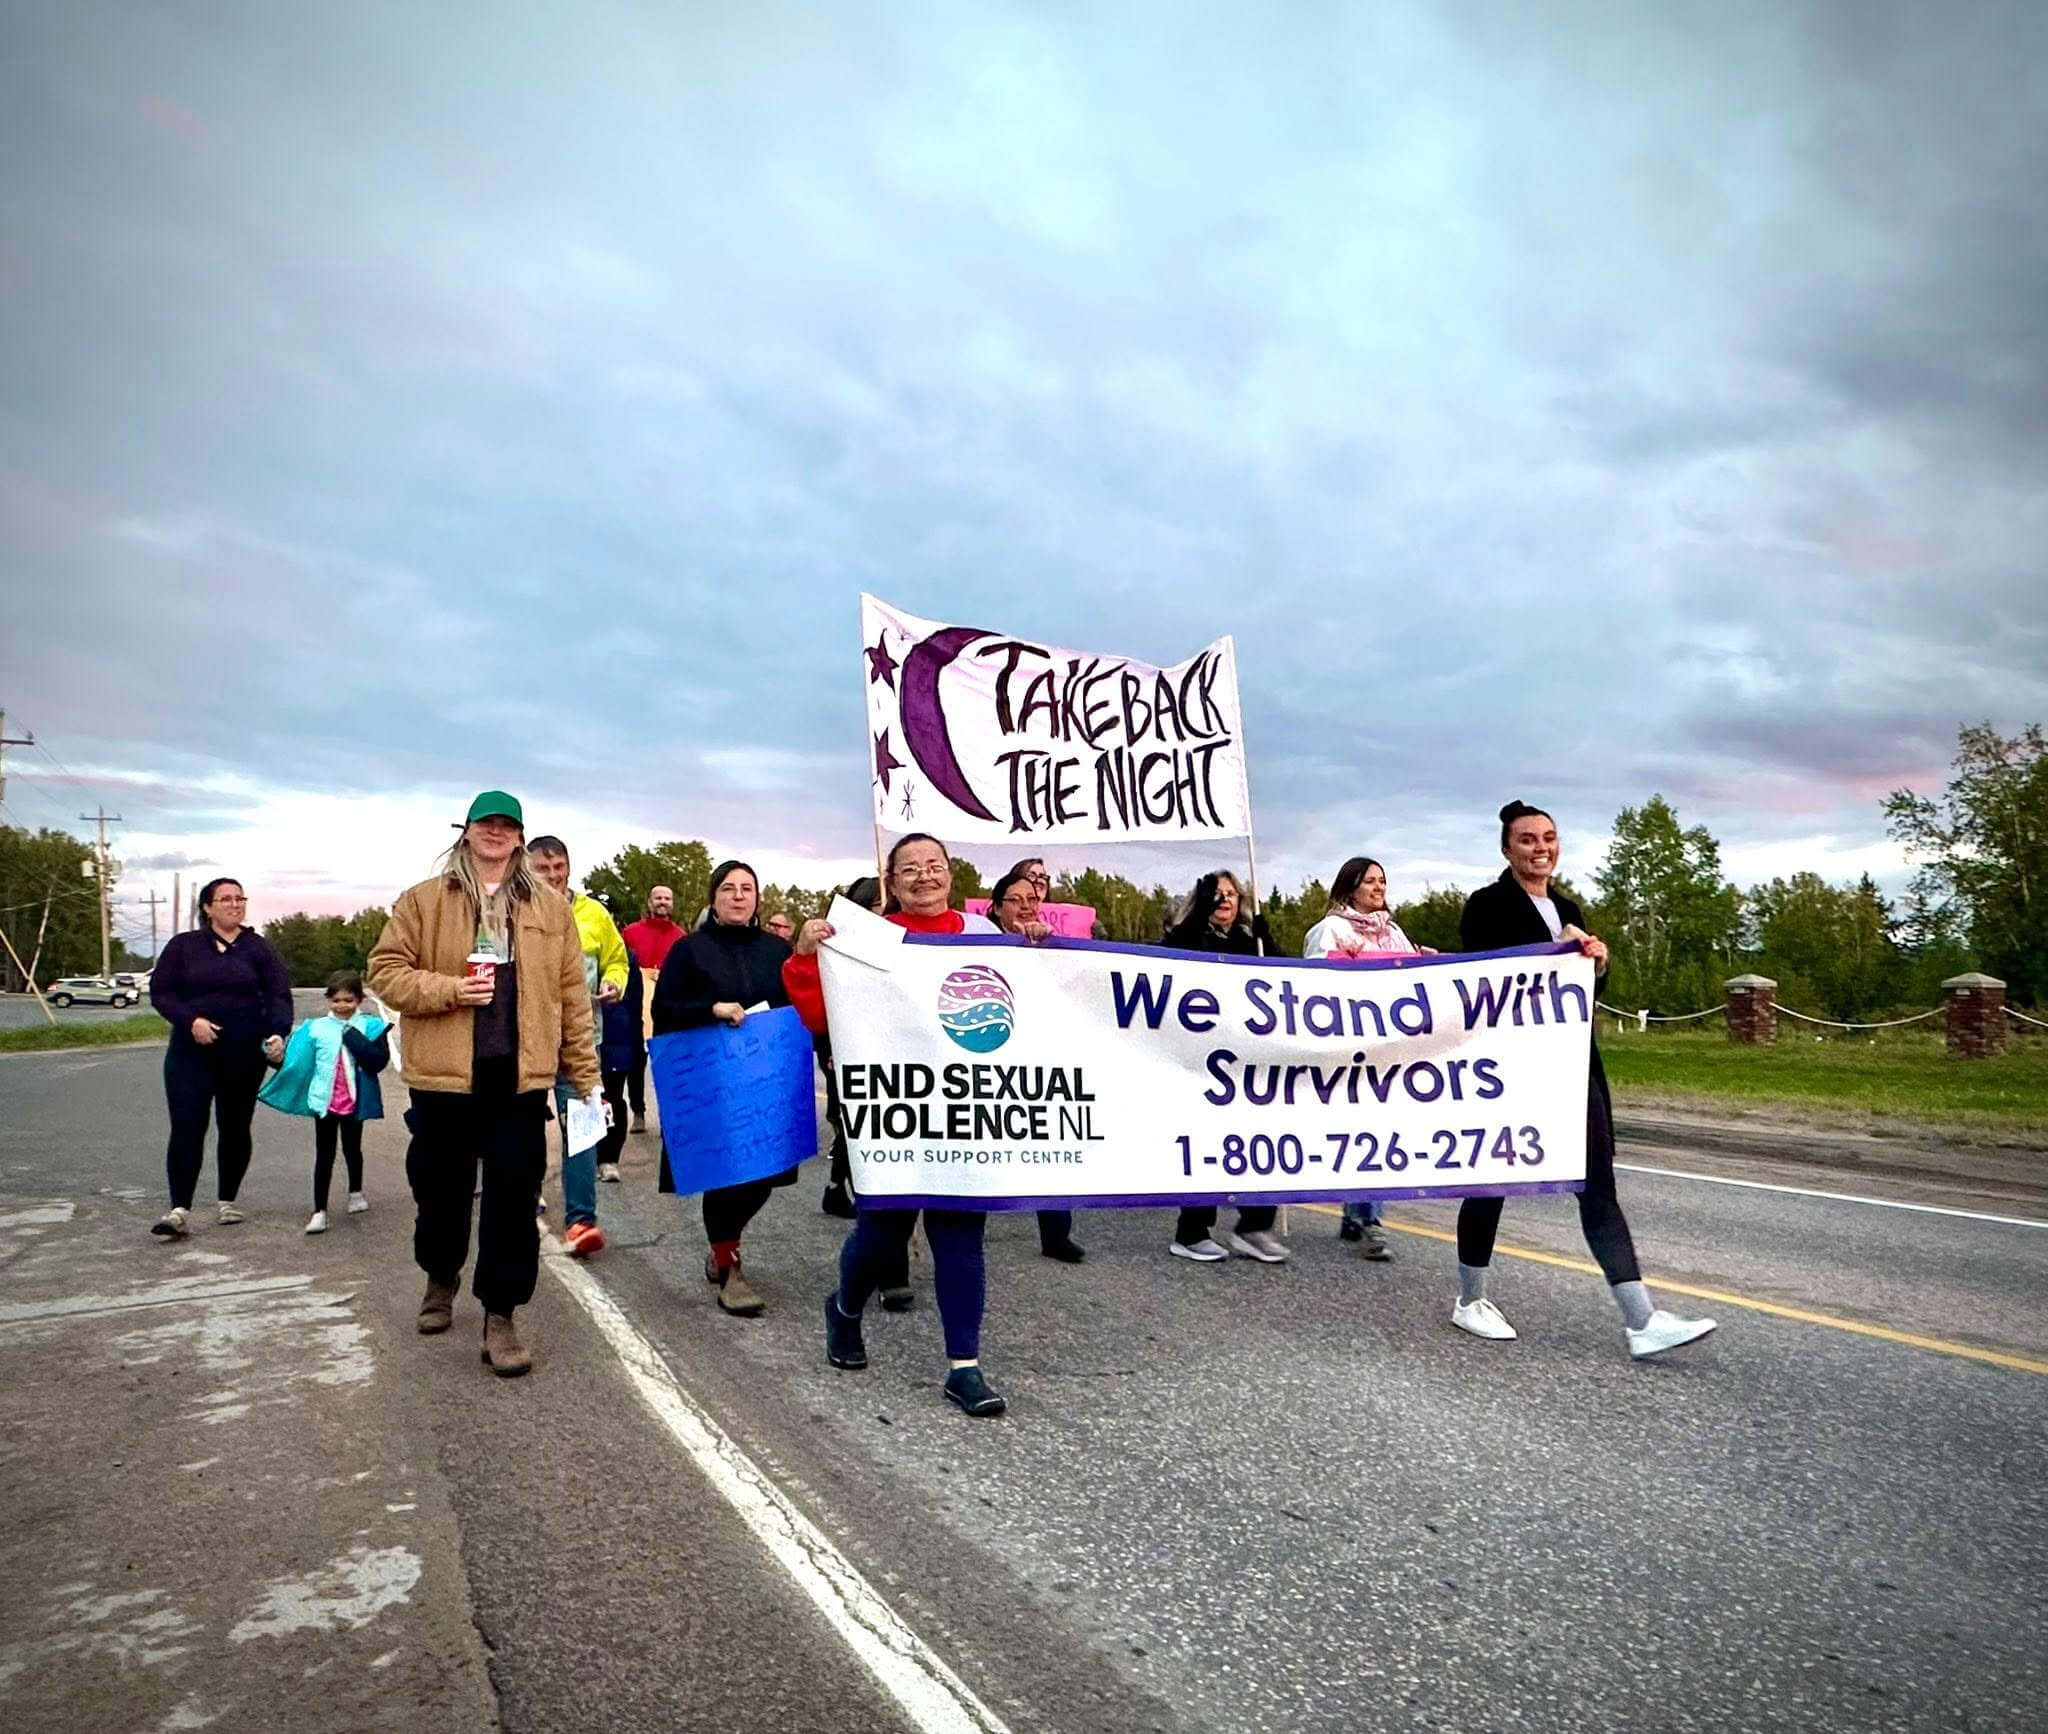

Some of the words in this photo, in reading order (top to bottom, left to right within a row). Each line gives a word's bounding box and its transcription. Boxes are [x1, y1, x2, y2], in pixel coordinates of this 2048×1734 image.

[975, 641, 1127, 752] TAKE
[1121, 650, 1231, 748] BACK
[993, 749, 1089, 834] THE
[1095, 738, 1232, 831] NIGHT
[1110, 971, 1221, 1033] We
[1245, 978, 1433, 1037] Stand
[1452, 969, 1589, 1030] With
[841, 1063, 935, 1100] END
[942, 1063, 1096, 1102] SEXUAL
[1203, 1048, 1504, 1107] Survivors
[840, 1102, 1050, 1141] VIOLENCE
[1059, 1105, 1105, 1141] NL
[860, 1150, 914, 1163] YOUR
[924, 1150, 1013, 1164] SUPPORT
[1020, 1151, 1083, 1164] CENTRE
[1175, 1125, 1545, 1176] 1-800-726-2743
